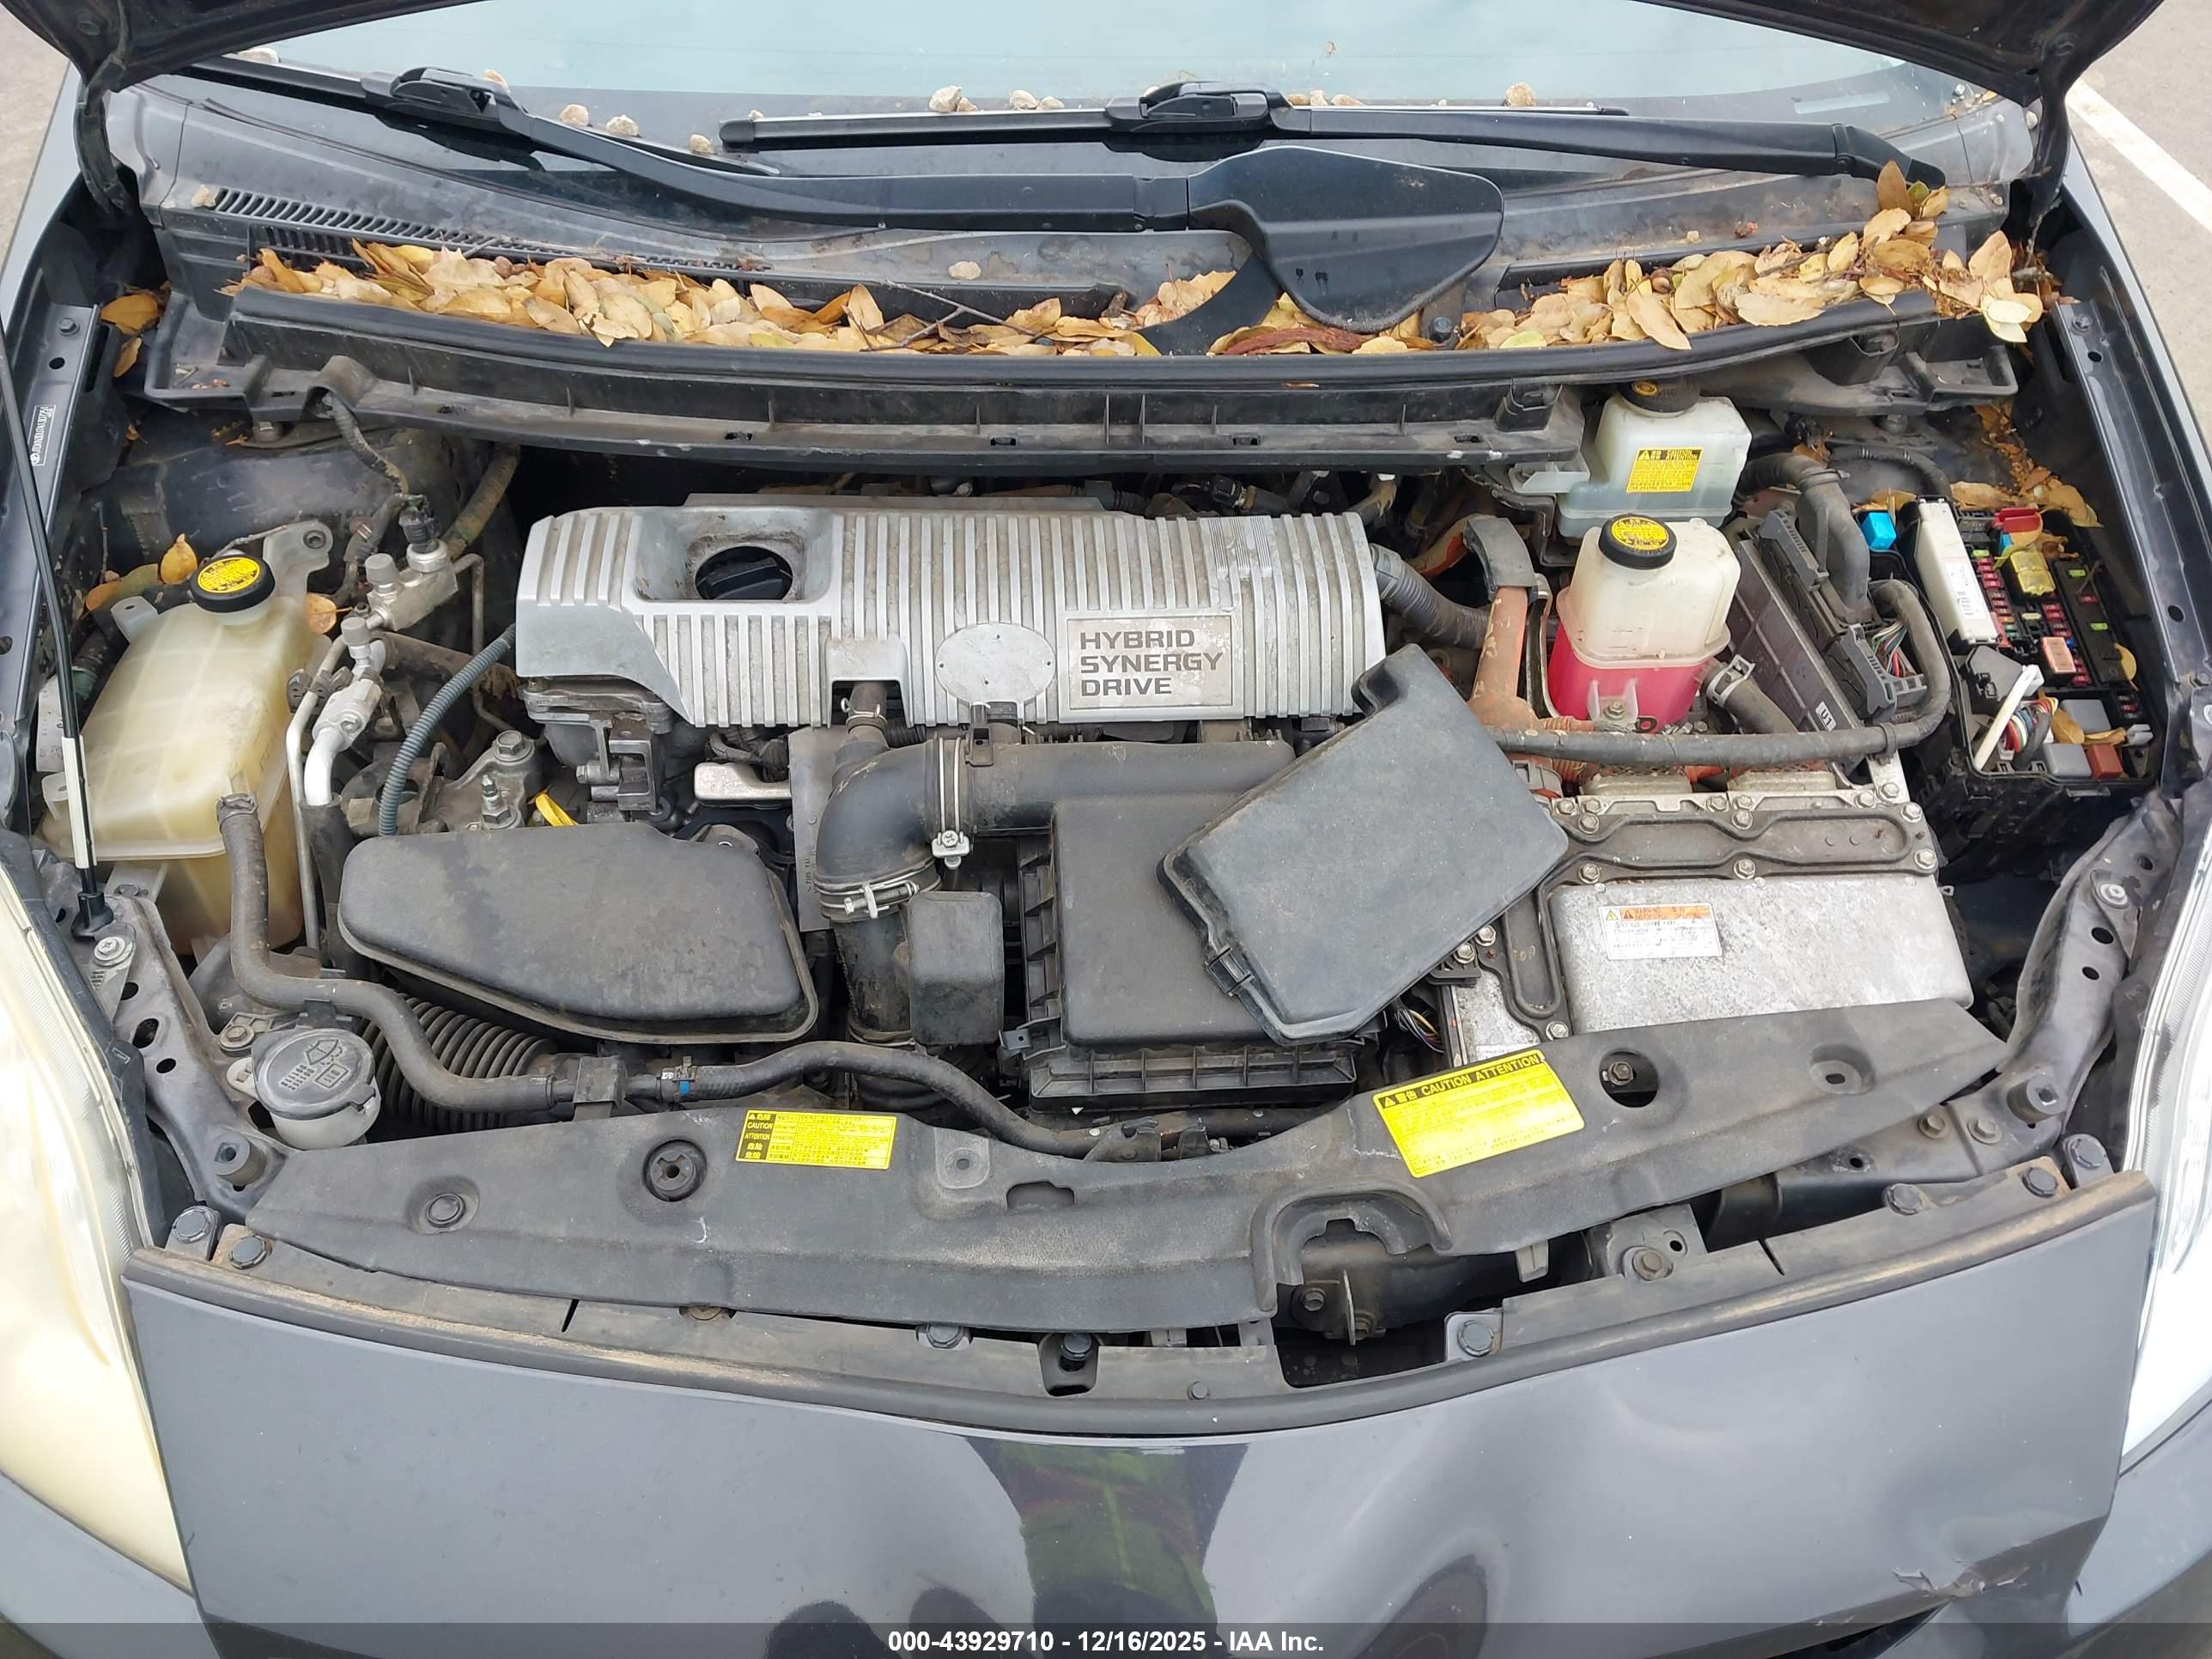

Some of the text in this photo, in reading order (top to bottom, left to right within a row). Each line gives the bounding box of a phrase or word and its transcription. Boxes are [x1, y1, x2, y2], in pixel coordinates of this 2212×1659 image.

[1080, 630, 1194, 649] HYBRID
[1081, 653, 1224, 674] SYNERGY
[1082, 678, 1172, 696] DRIVE
[1821, 709, 1832, 726] U1
[1422, 1074, 1472, 1096] CAUTION
[1475, 1054, 1540, 1082] ATTENTION
